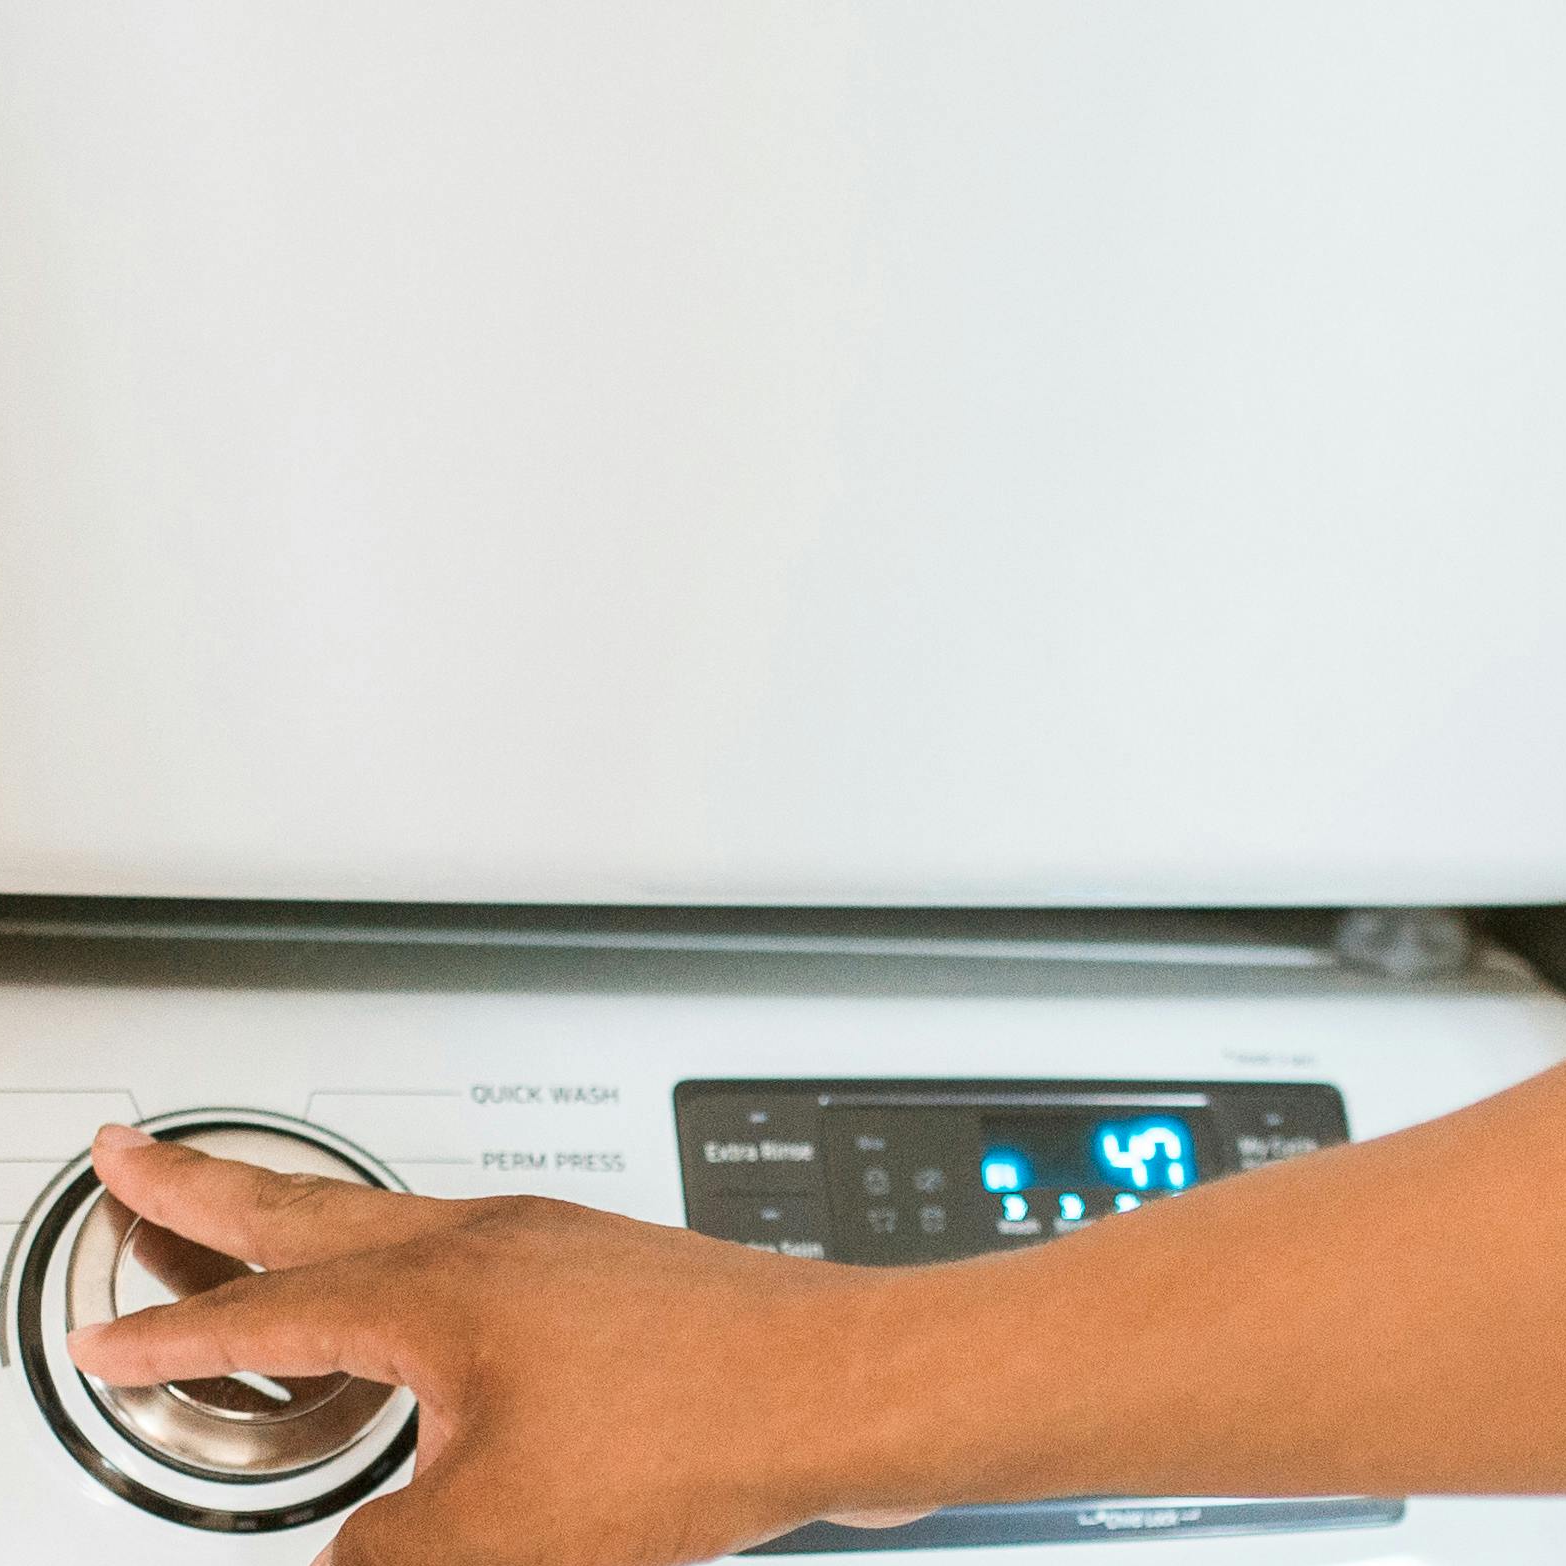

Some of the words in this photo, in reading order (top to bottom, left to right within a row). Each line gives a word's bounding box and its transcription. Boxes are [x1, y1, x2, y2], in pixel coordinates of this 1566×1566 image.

[470, 1085, 541, 1105] QUICK
[549, 1086, 621, 1105] WASH
[482, 1152, 547, 1171] PERM
[553, 1152, 626, 1173] PRESS
[703, 1141, 759, 1163] Extra
